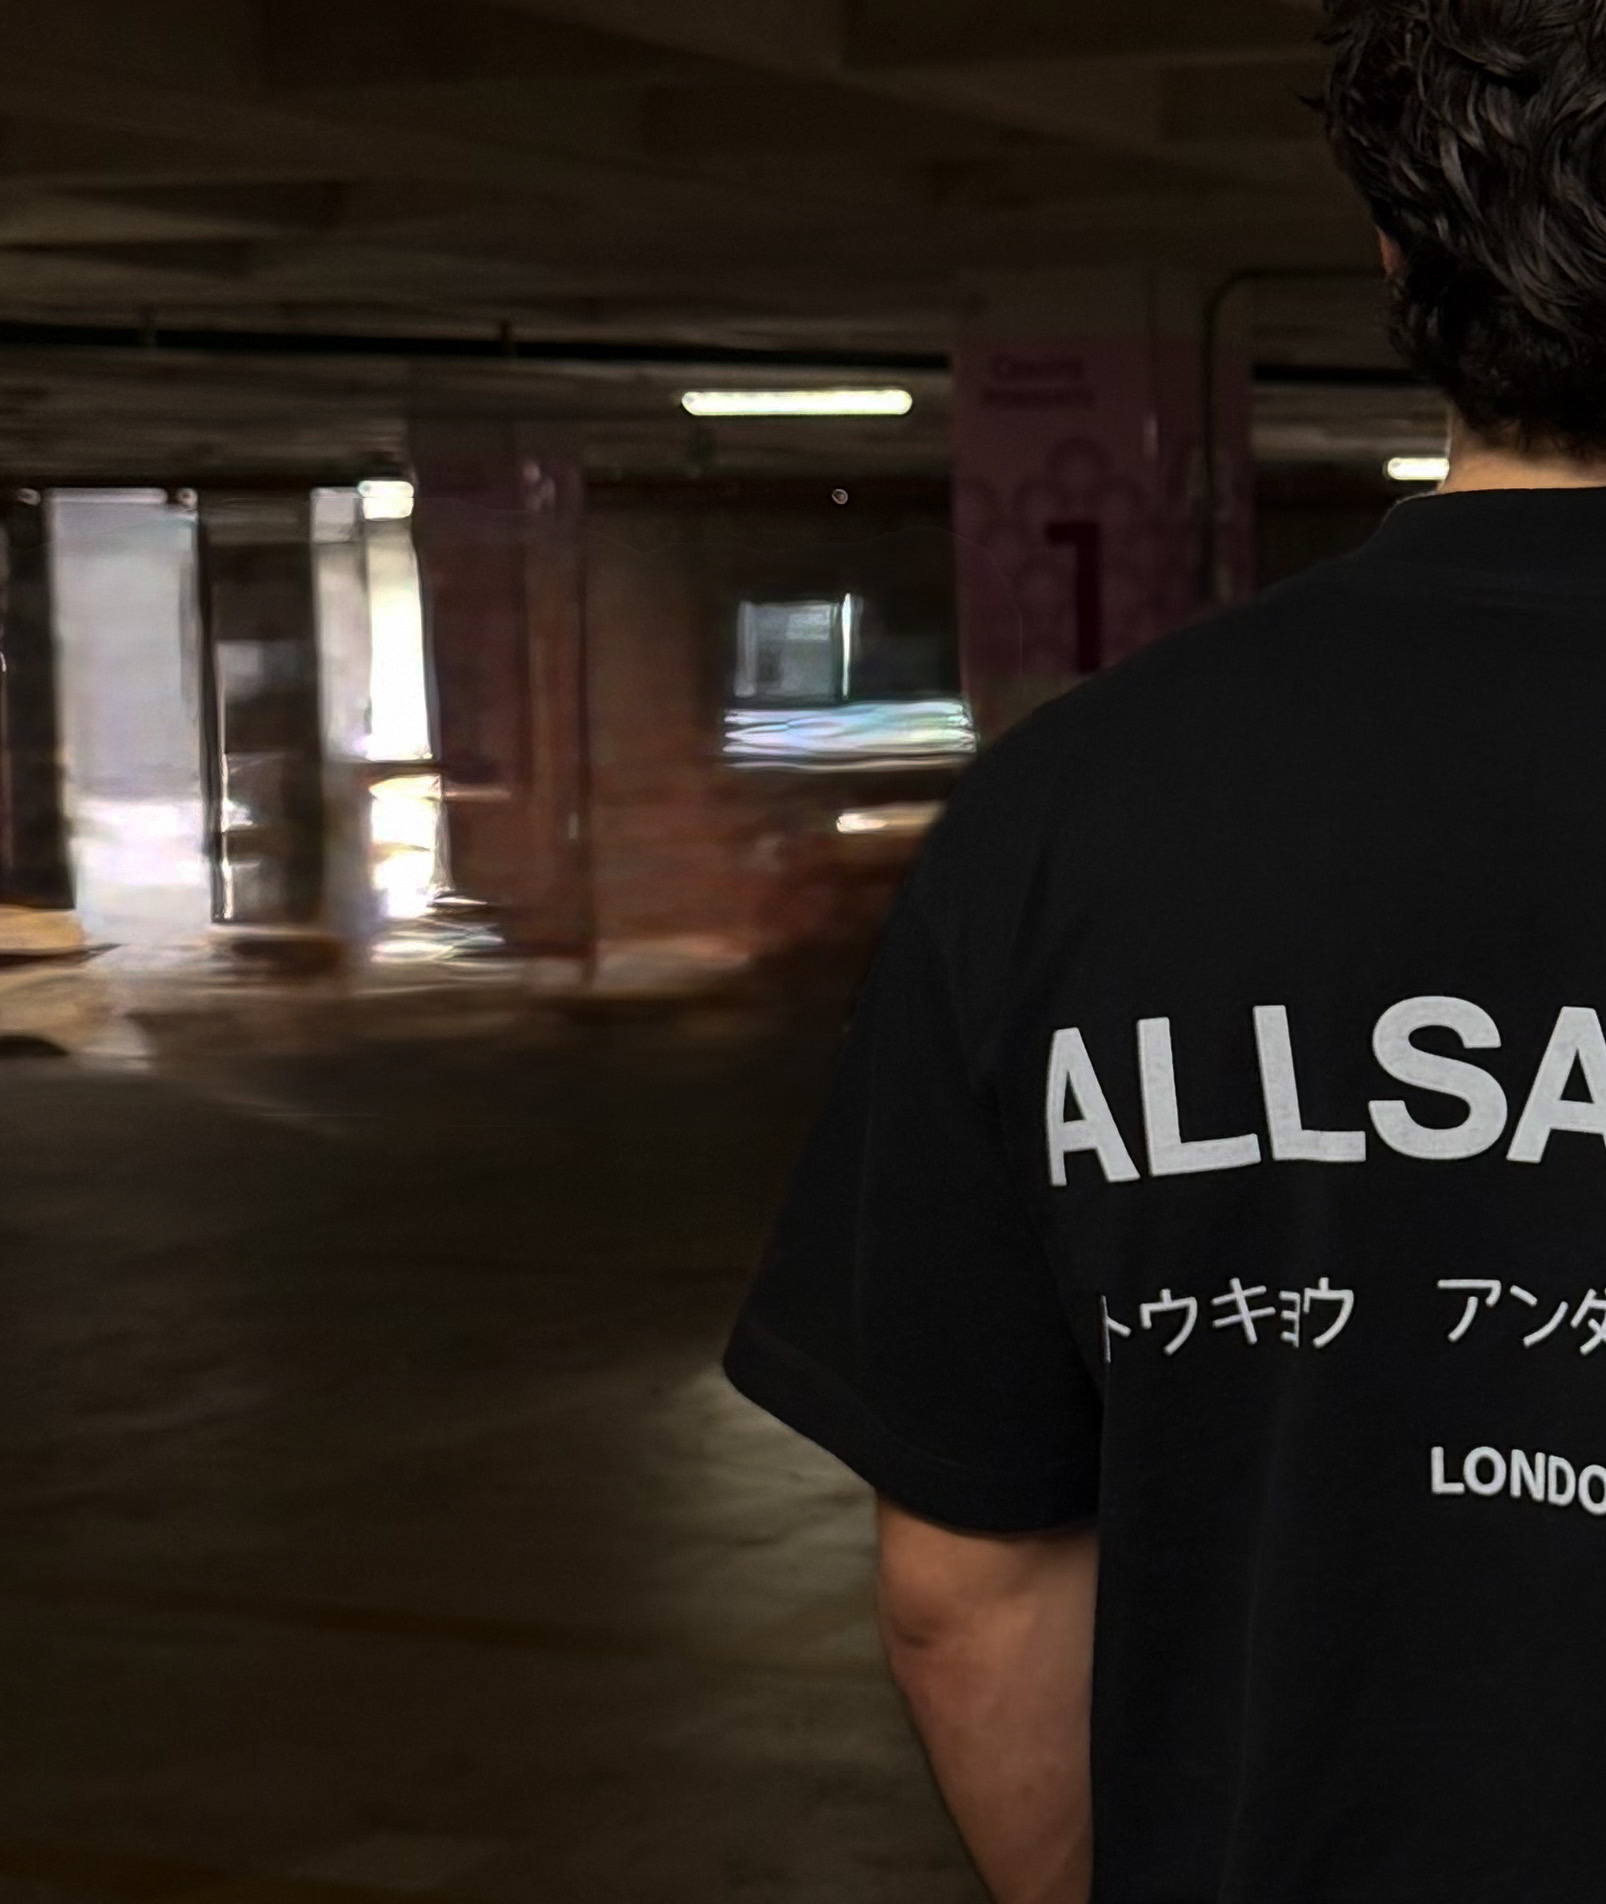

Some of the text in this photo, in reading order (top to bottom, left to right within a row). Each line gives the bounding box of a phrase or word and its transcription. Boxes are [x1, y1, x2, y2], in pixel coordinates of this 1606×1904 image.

[1099, 1276, 1355, 1364] トウキョウ
